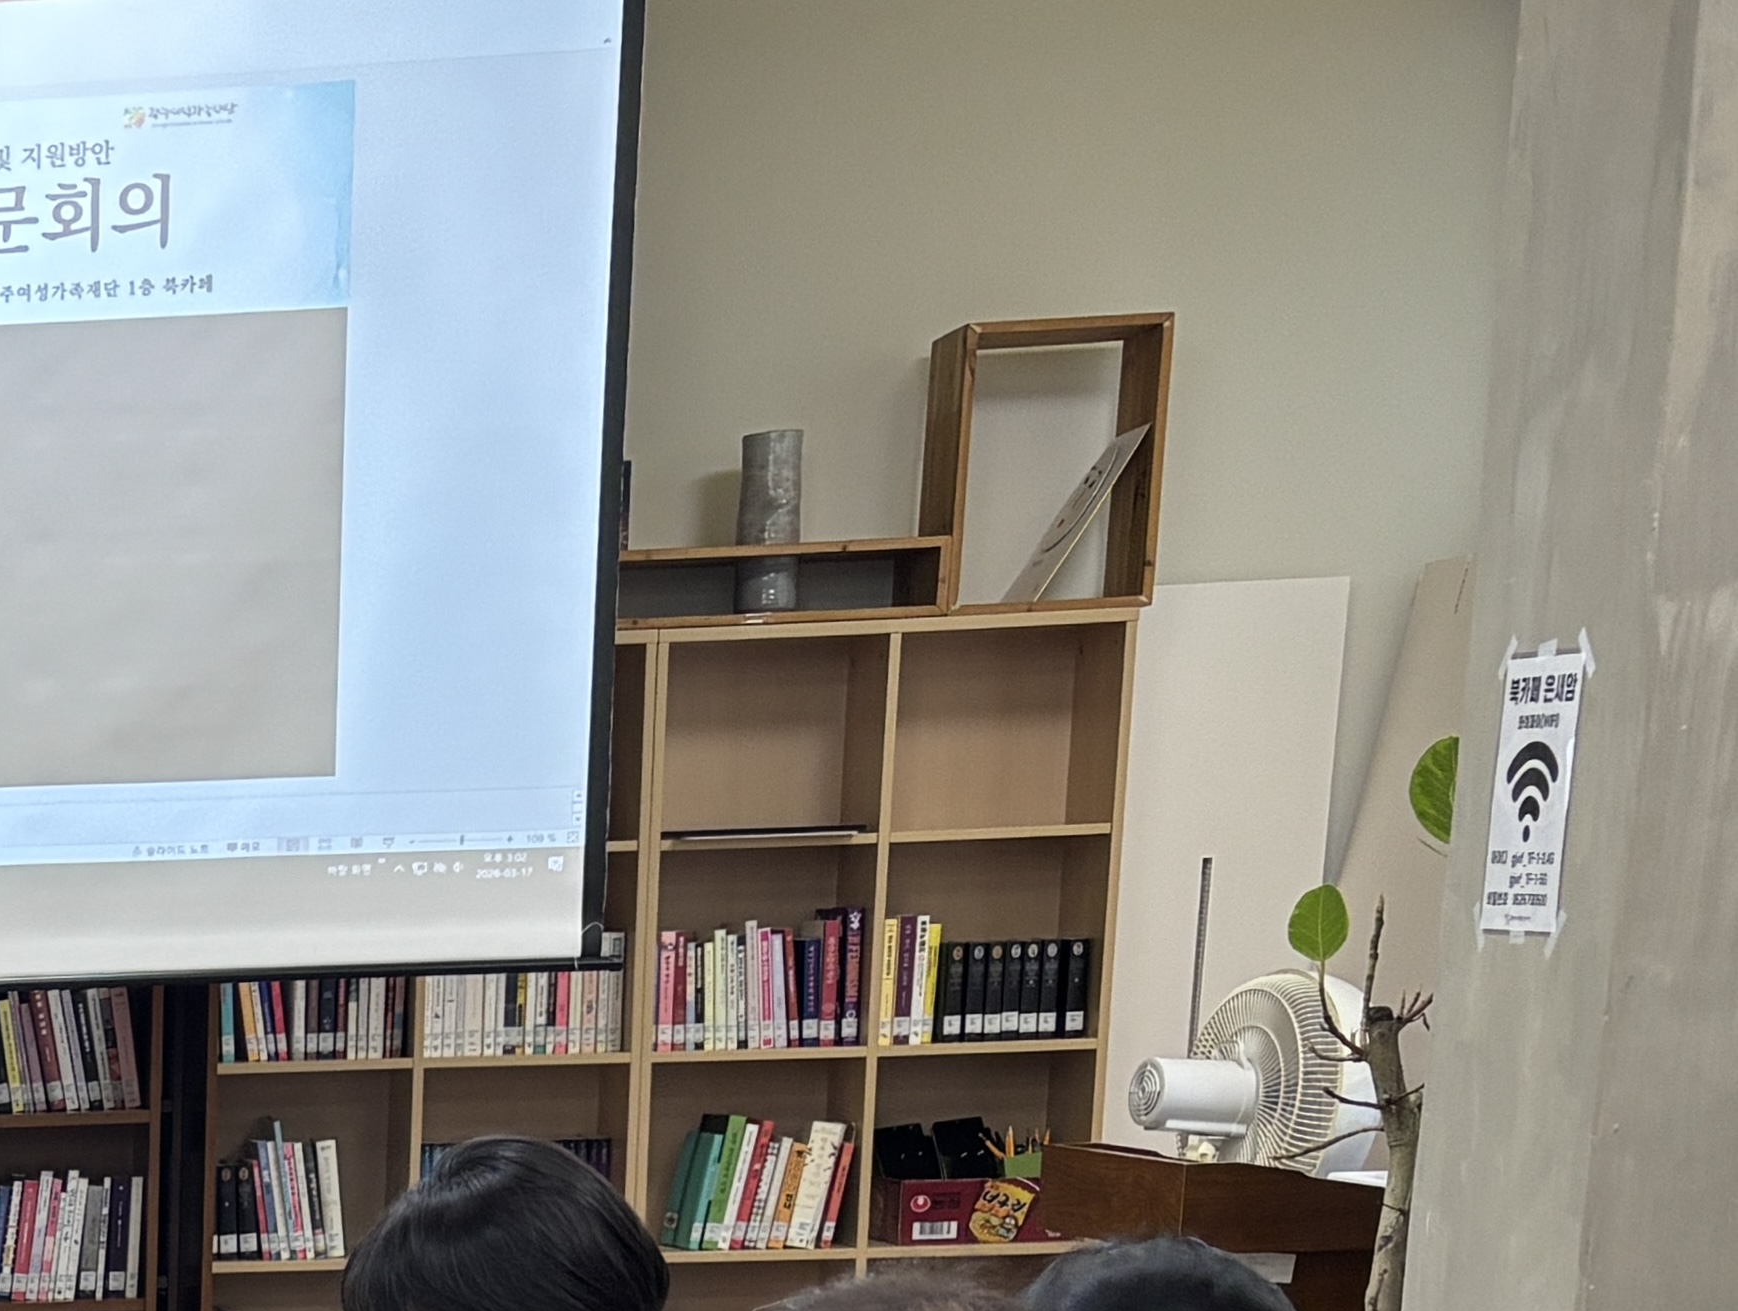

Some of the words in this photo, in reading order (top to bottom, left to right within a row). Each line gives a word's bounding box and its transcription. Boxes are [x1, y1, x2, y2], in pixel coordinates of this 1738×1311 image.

[21, 139, 115, 170] 지원방안
[128, 277, 155, 297] 1층
[162, 273, 214, 295] 북카페
[1508, 676, 1542, 705] 북카페
